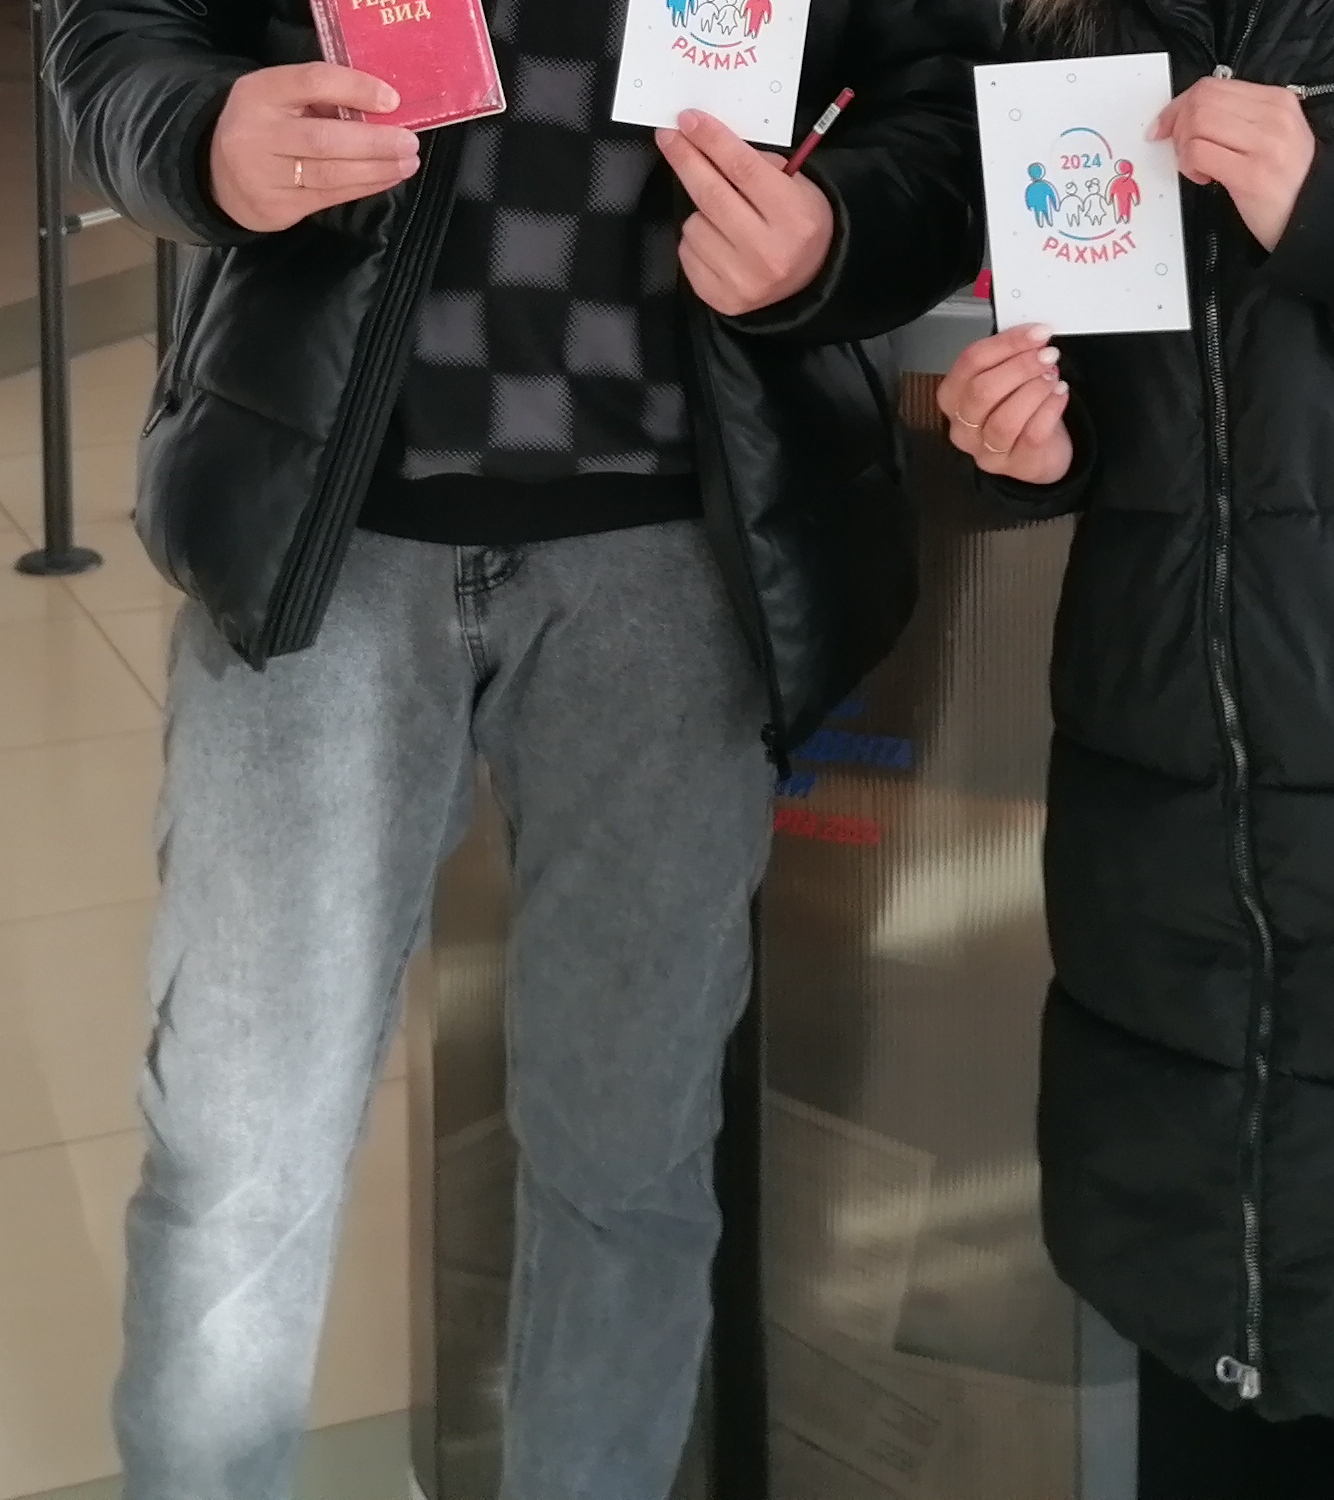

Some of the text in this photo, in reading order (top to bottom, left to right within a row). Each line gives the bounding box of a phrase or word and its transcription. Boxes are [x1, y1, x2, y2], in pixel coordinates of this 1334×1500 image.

[671, 35, 758, 71] РАХМАТ
[1060, 152, 1102, 170] 2024
[1042, 230, 1136, 264] РАХМАТ
